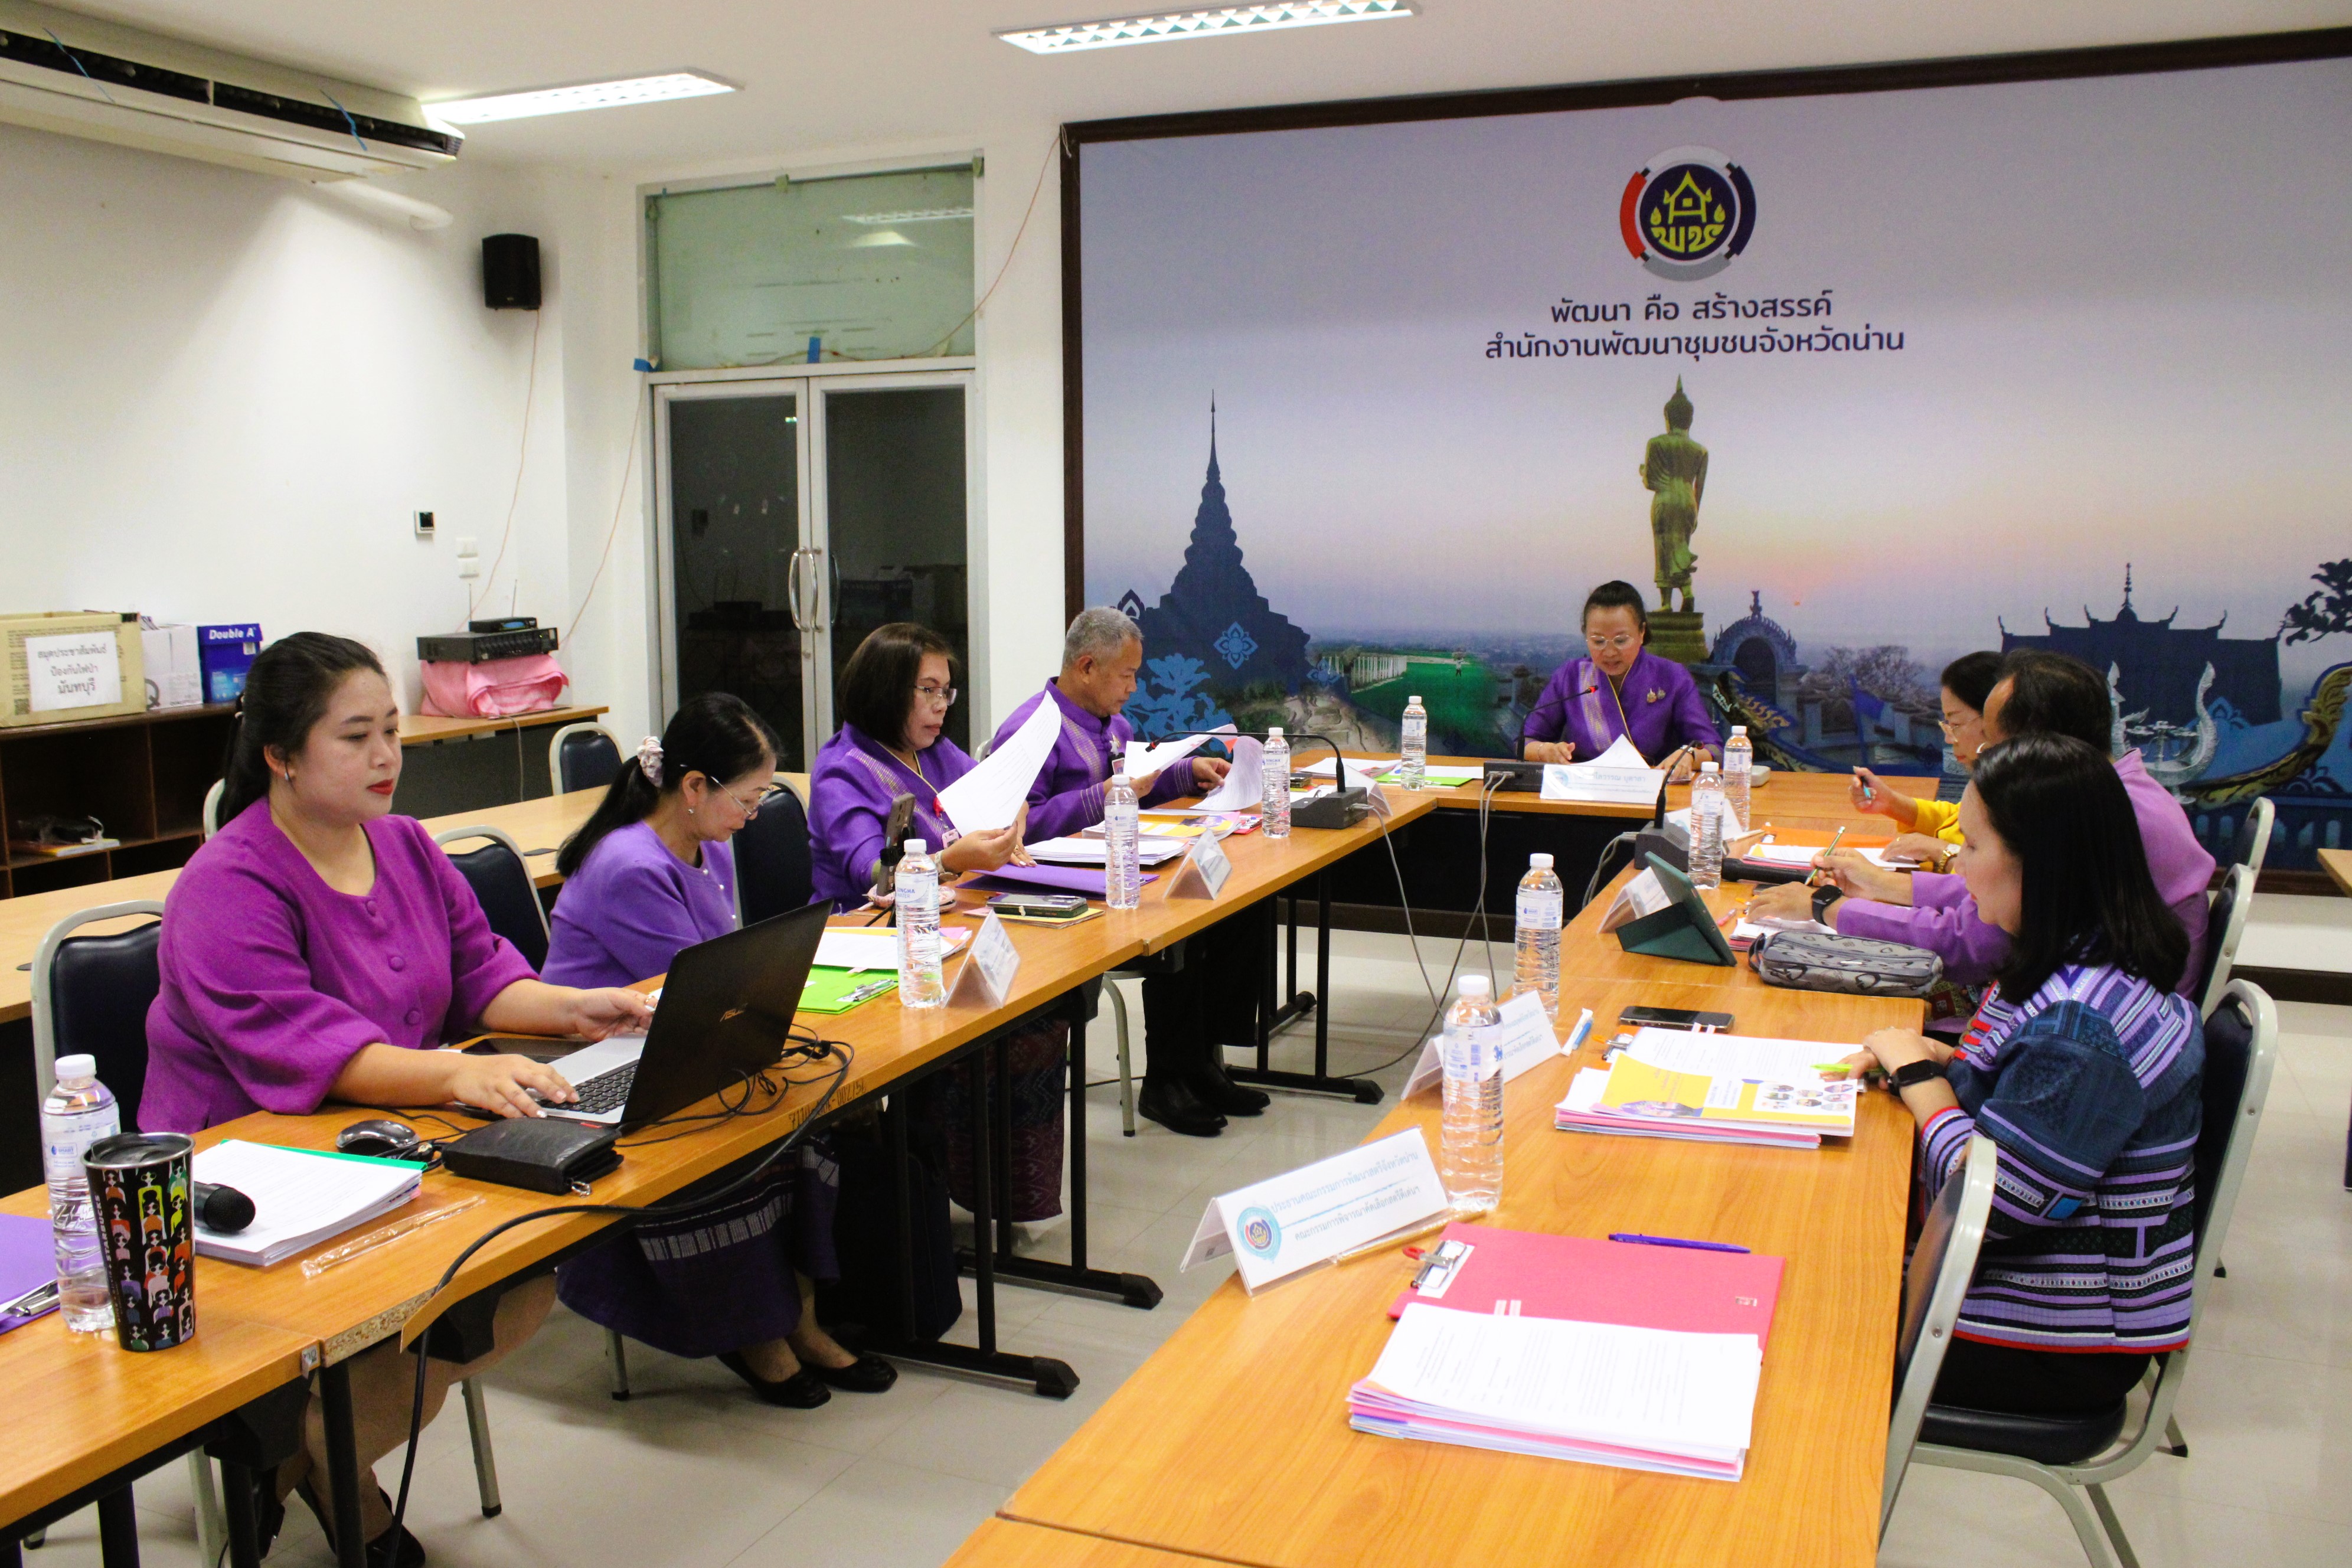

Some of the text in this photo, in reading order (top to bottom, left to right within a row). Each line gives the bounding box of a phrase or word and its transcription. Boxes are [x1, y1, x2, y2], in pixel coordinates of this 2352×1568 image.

[1551, 289, 1833, 322] พัฒนา คือ สร้างสรรค์
[1485, 324, 1905, 361] สำนักงานพัฒนาชุมชนจังหวัดน่าน
[209, 628, 254, 640] Double A
[95, 1195, 112, 1262] STARBUCKS
